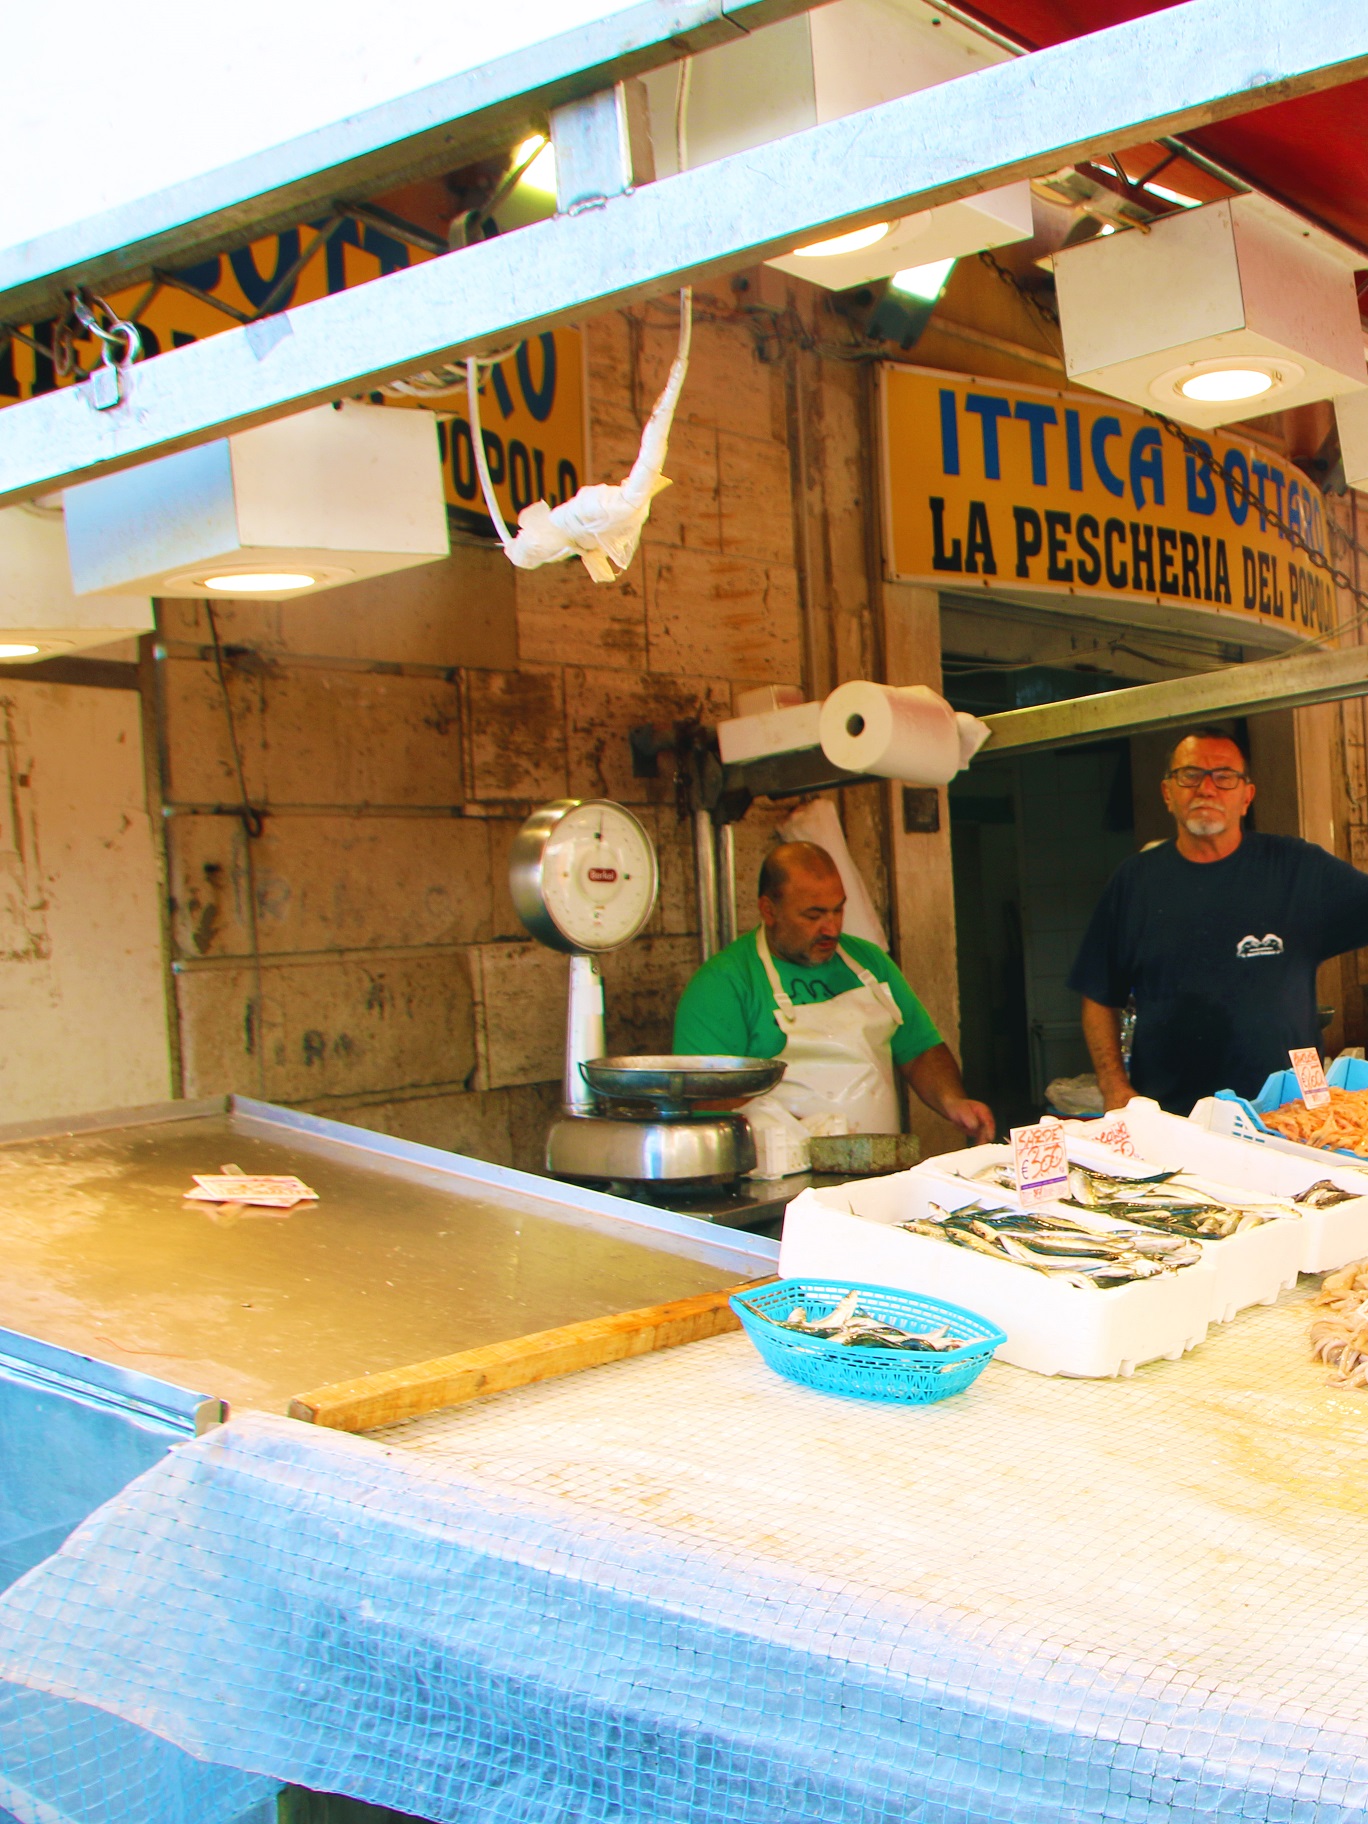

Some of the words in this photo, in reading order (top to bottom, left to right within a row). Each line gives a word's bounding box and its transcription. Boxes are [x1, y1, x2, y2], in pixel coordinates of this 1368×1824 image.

[938, 389, 1166, 511] ITTICA
[1184, 437, 1324, 554] BOTTARO
[929, 496, 997, 575] LA
[1012, 505, 1232, 605] PESCHERIA
[1241, 545, 1285, 618] DEL
[1288, 562, 1334, 634] POPOLO
